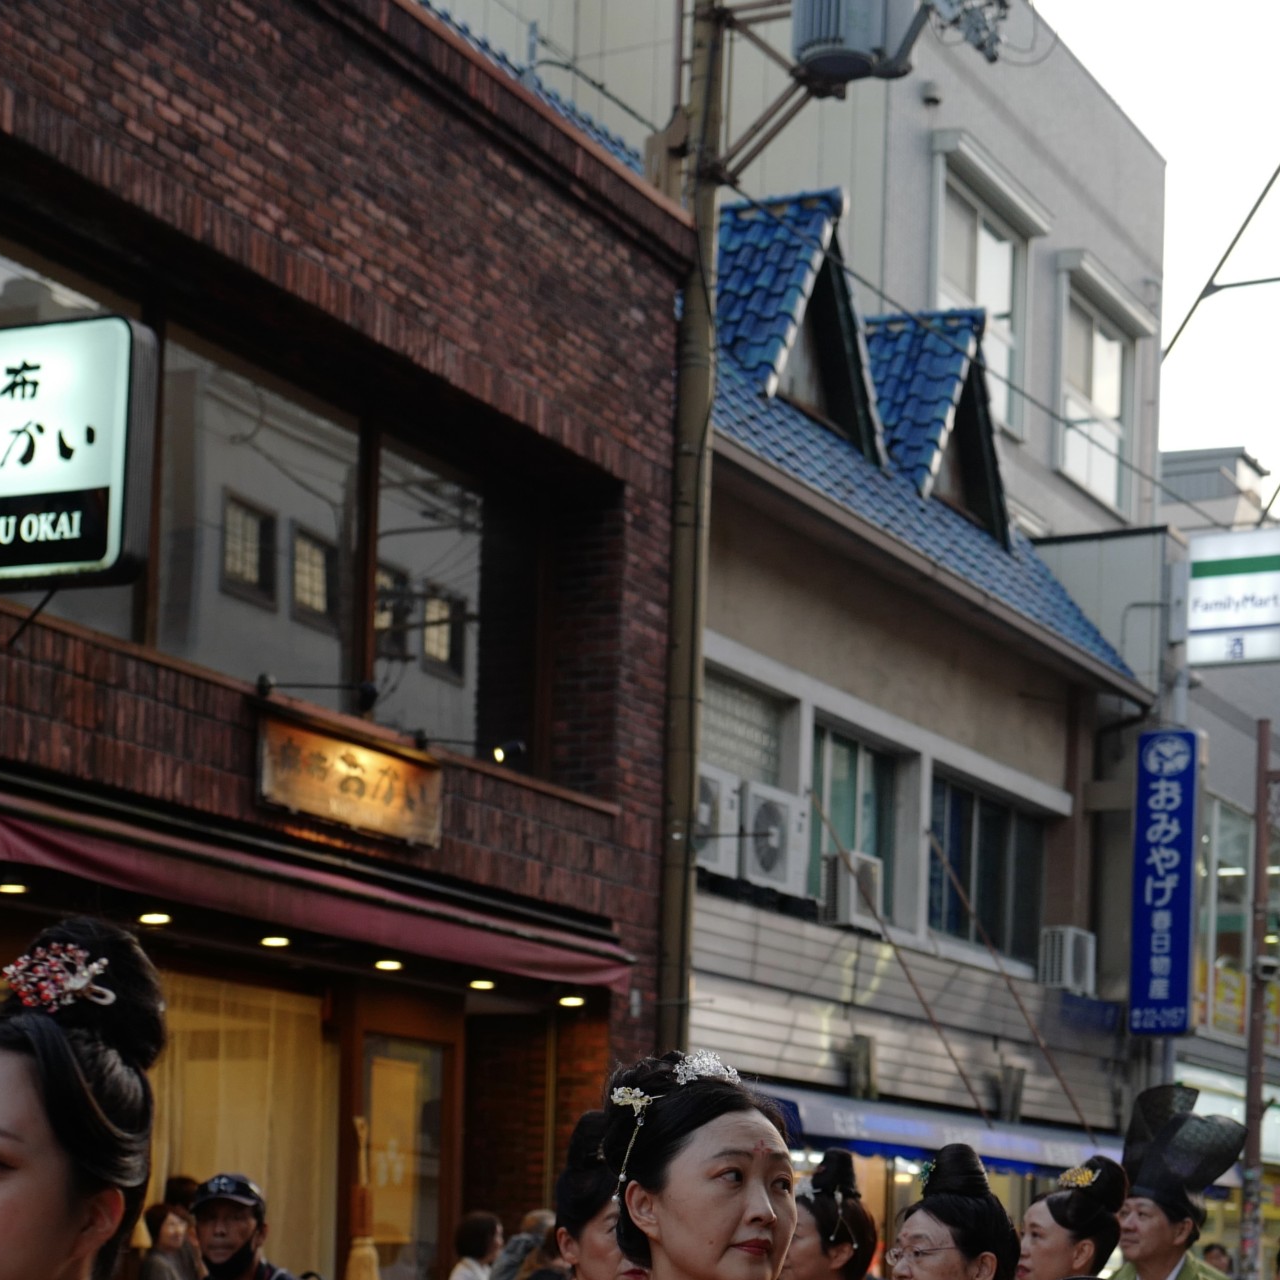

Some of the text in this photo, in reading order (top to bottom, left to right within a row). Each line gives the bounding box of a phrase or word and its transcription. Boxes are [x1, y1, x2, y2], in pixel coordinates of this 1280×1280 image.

[20, 510, 82, 543] OKAI
[1192, 593, 1280, 614] FamilyMart
[1144, 778, 1183, 908] おみやげ
